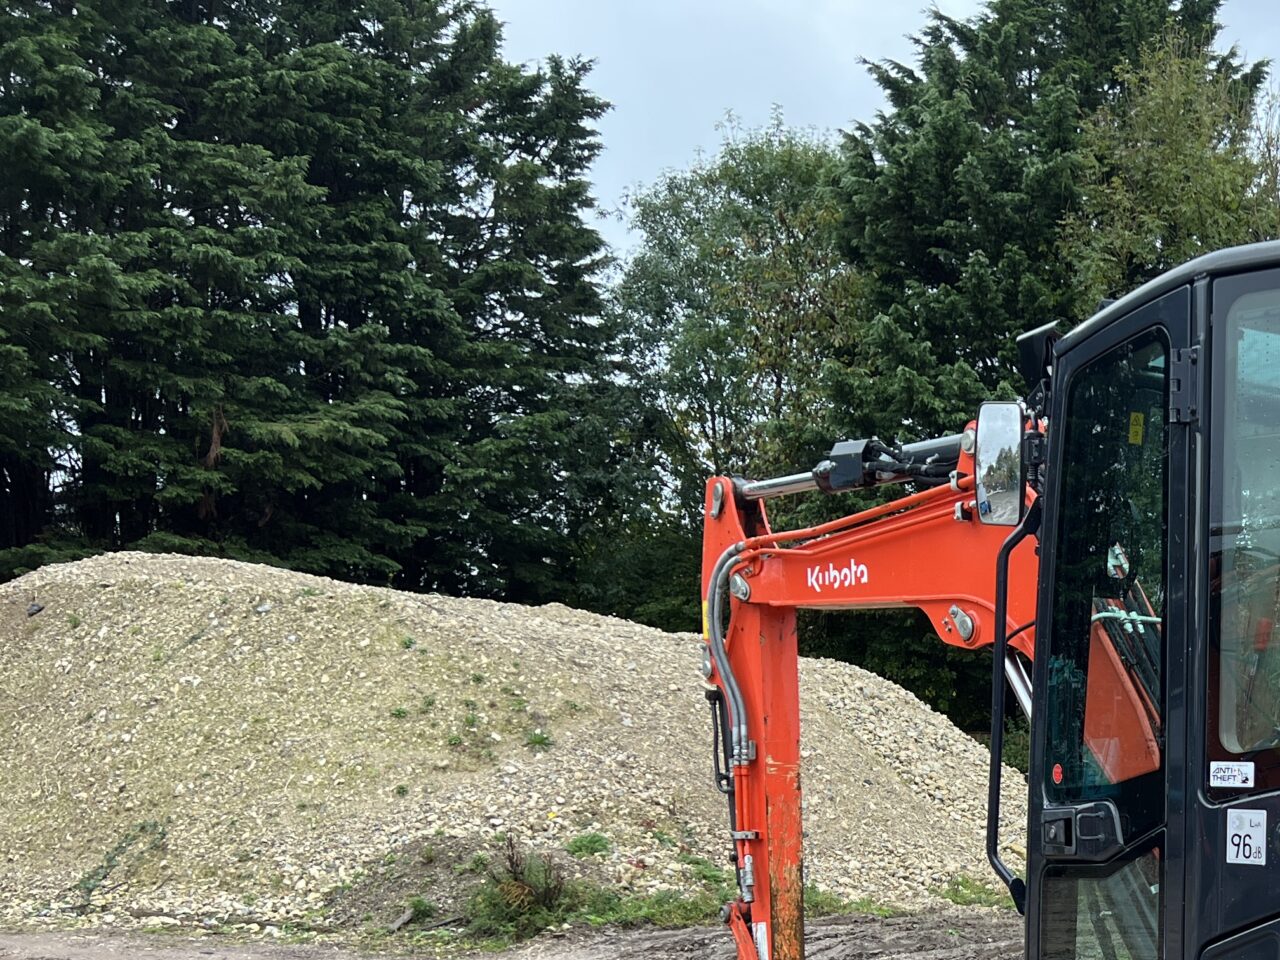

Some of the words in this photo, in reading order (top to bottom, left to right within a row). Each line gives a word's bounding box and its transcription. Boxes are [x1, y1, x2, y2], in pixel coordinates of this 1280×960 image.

[806, 558, 869, 593] Kubota
[1212, 774, 1237, 782] THEFT
[1231, 833, 1252, 859] 96
[1252, 846, 1263, 859] dB
